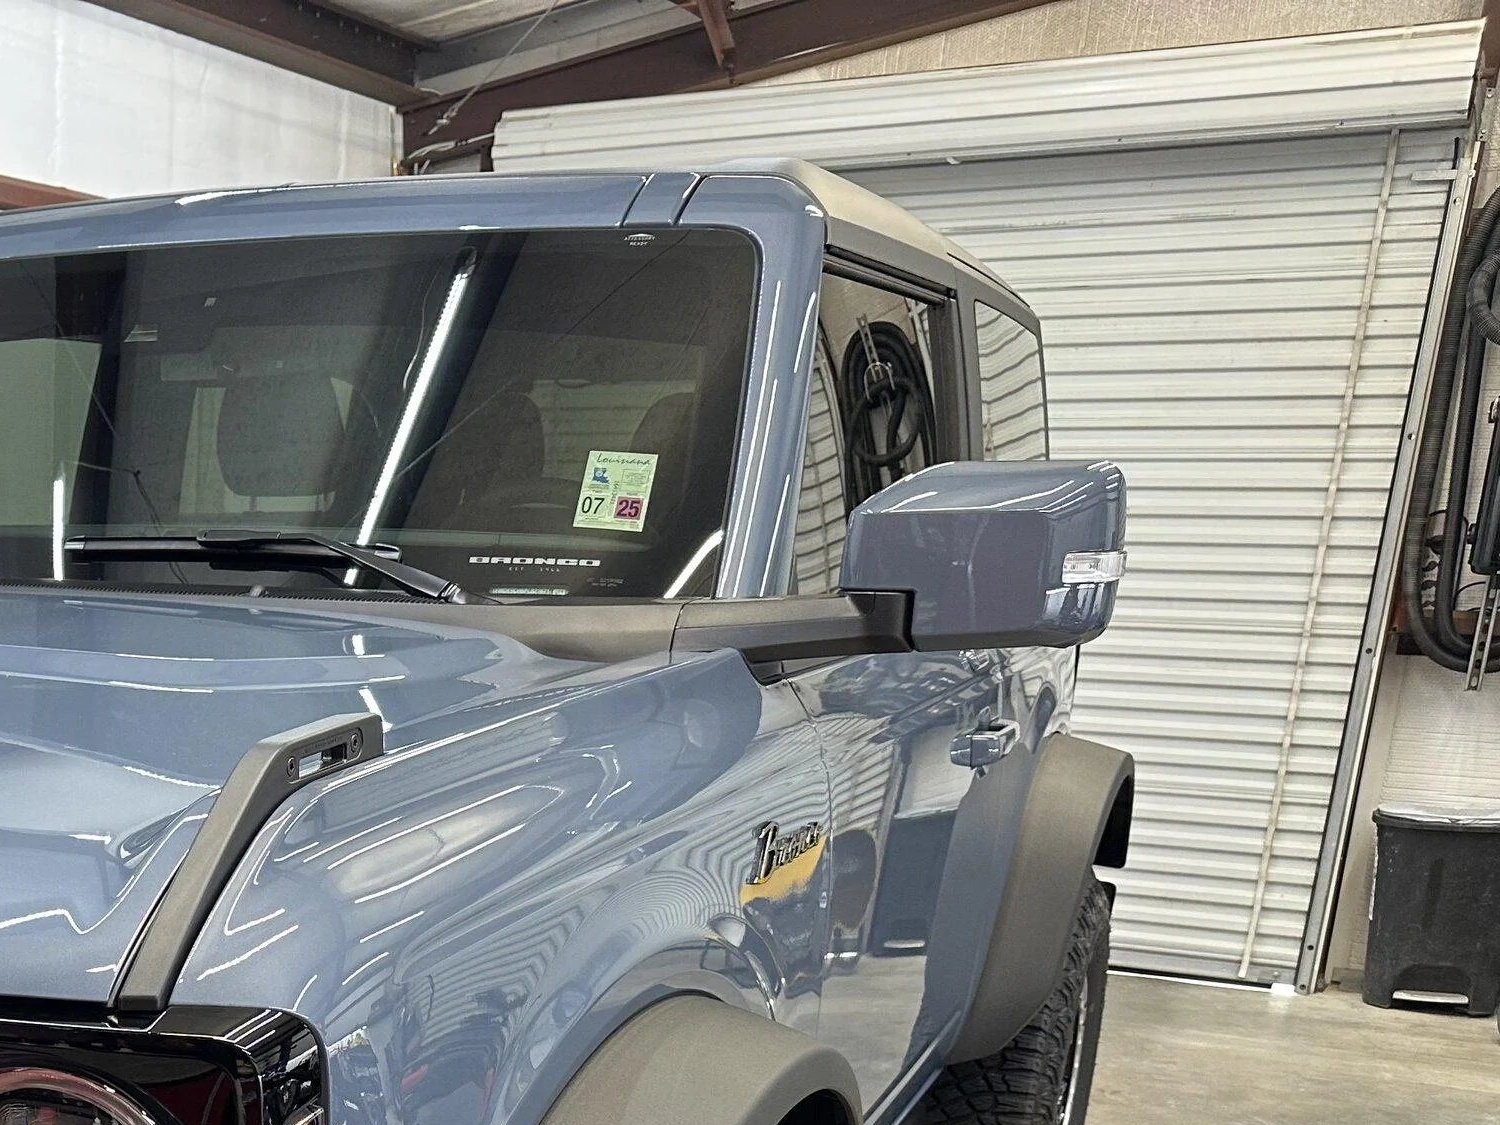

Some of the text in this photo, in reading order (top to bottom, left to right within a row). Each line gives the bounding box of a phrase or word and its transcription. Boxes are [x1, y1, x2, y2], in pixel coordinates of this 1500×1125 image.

[596, 452, 651, 466] Louisiana
[581, 496, 641, 518] 07 25
[469, 556, 601, 566] BRONCO
